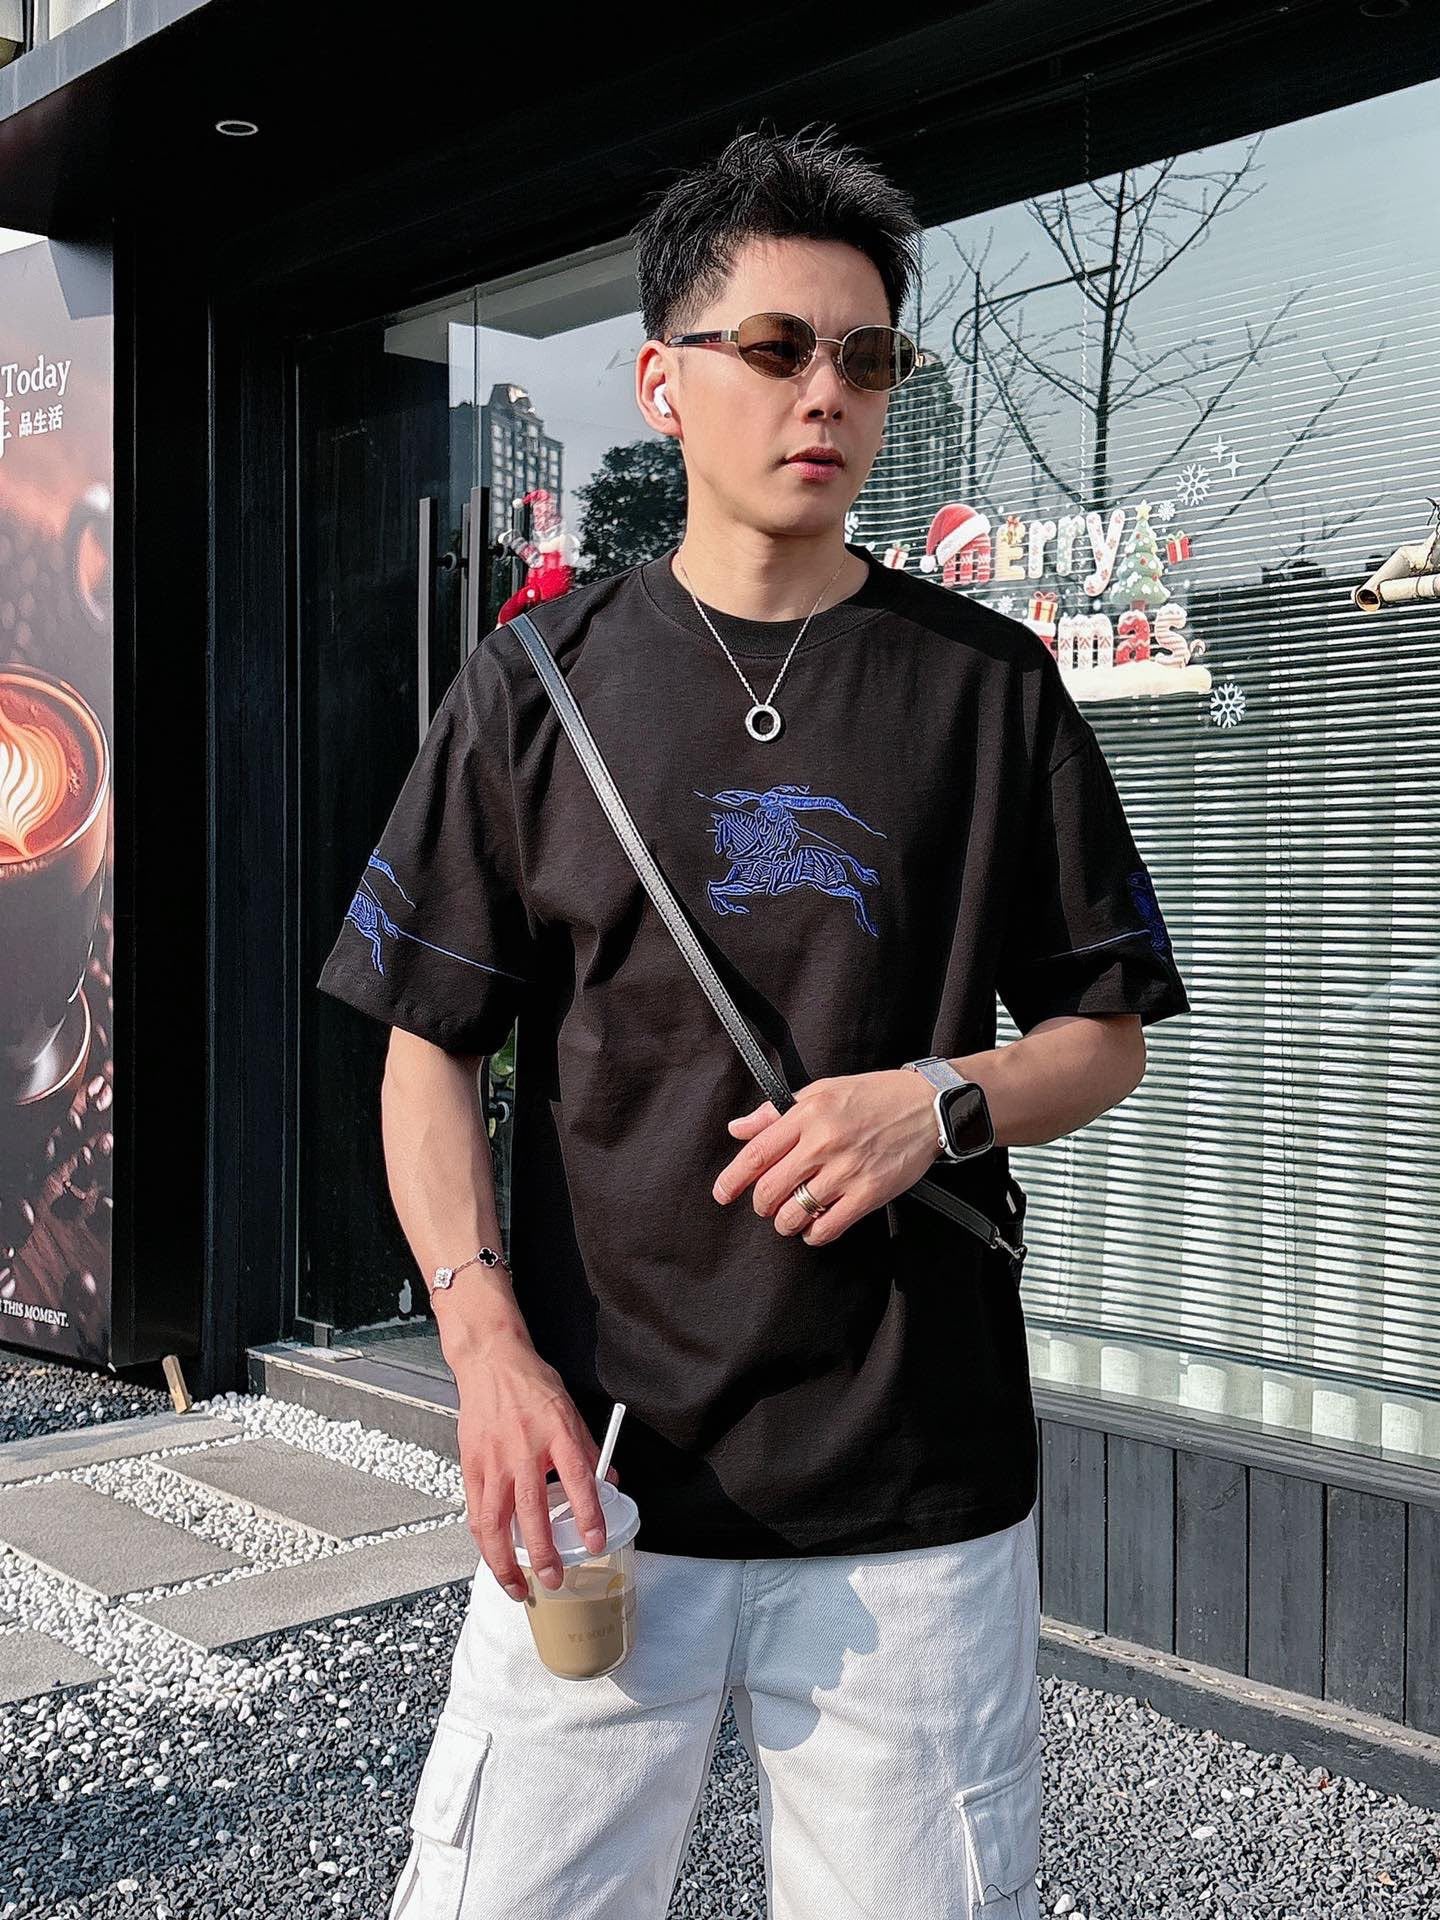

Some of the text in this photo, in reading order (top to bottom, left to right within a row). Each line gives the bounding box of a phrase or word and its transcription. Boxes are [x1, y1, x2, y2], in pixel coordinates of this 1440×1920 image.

[1, 354, 72, 398] Today
[19, 403, 64, 438] 品生活
[3, 1299, 24, 1317] THIS
[24, 1304, 70, 1327] MOMENT.
